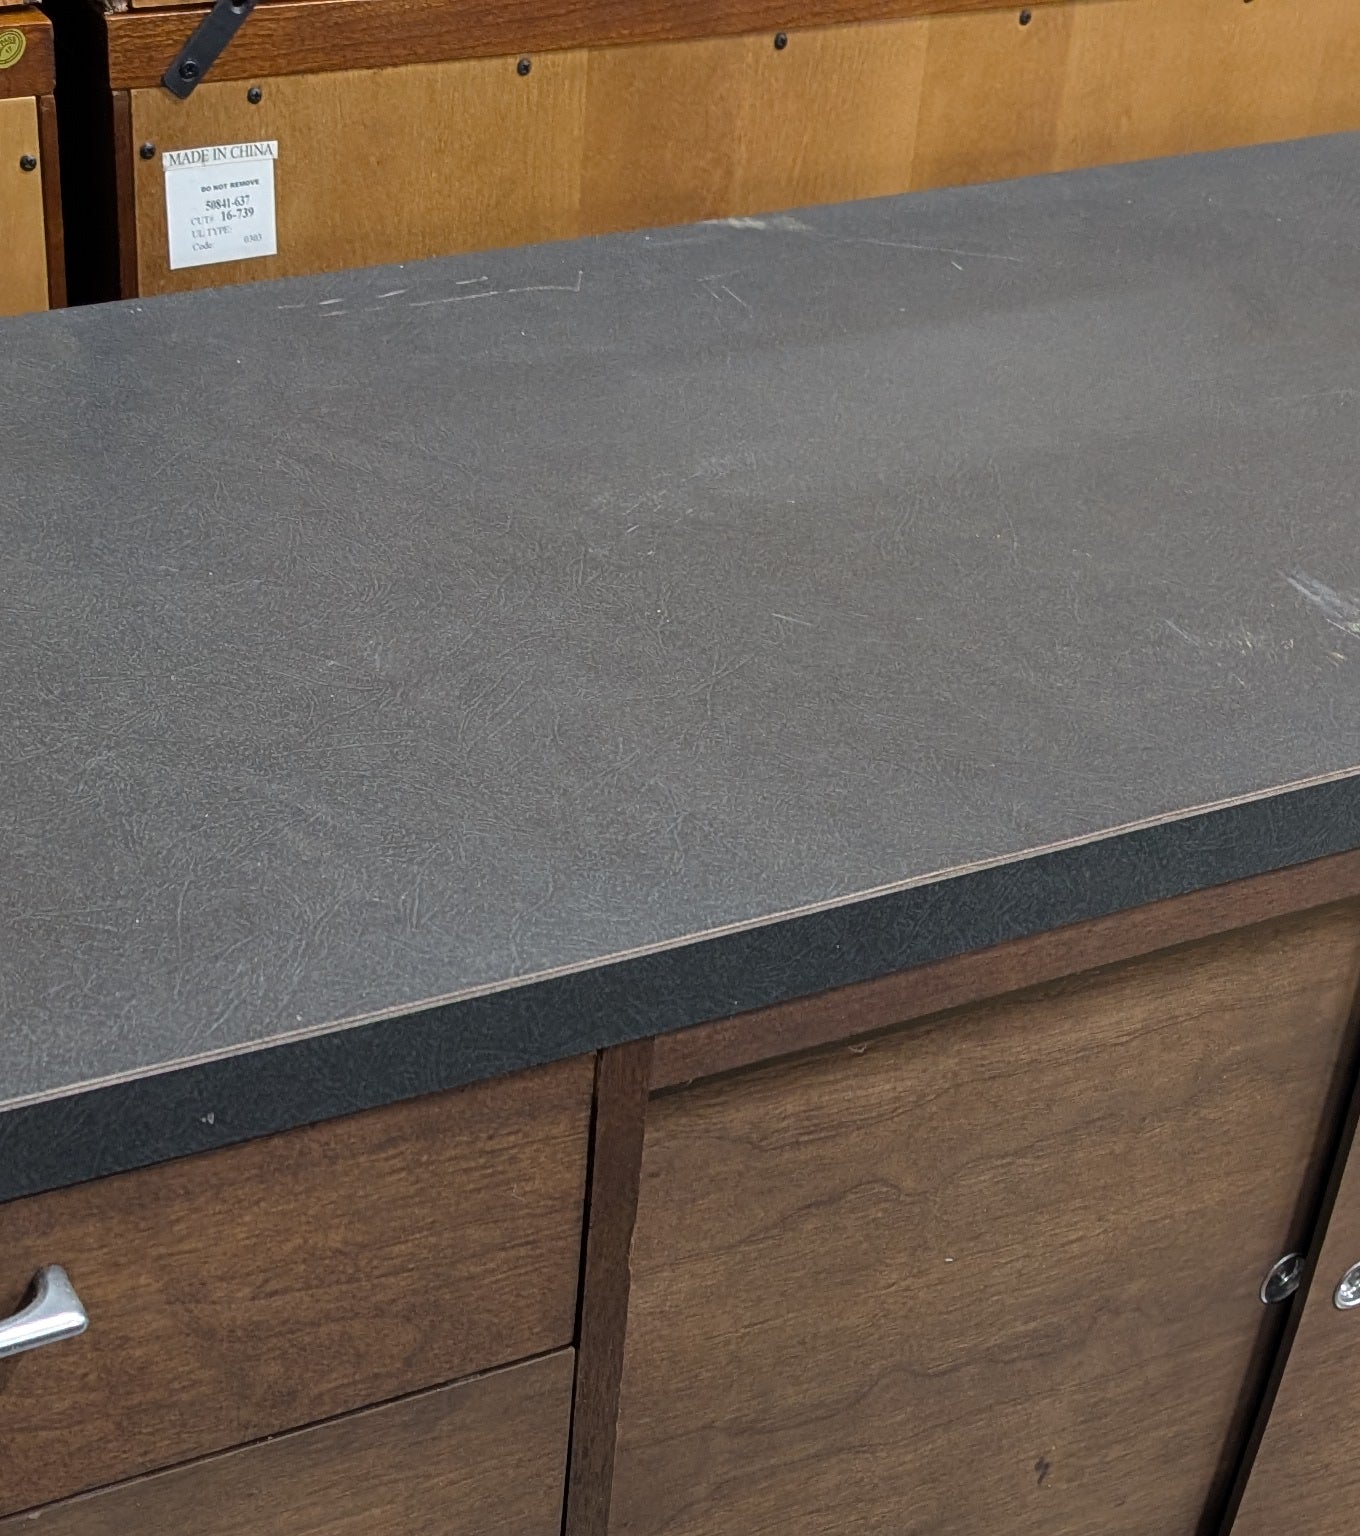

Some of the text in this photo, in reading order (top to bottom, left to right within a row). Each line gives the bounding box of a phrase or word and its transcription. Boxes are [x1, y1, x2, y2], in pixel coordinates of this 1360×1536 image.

[169, 143, 273, 166] MADE IN CHINA
[213, 183, 228, 191] NOT
[230, 179, 259, 188] REMOVE
[221, 207, 255, 222] 16-739
